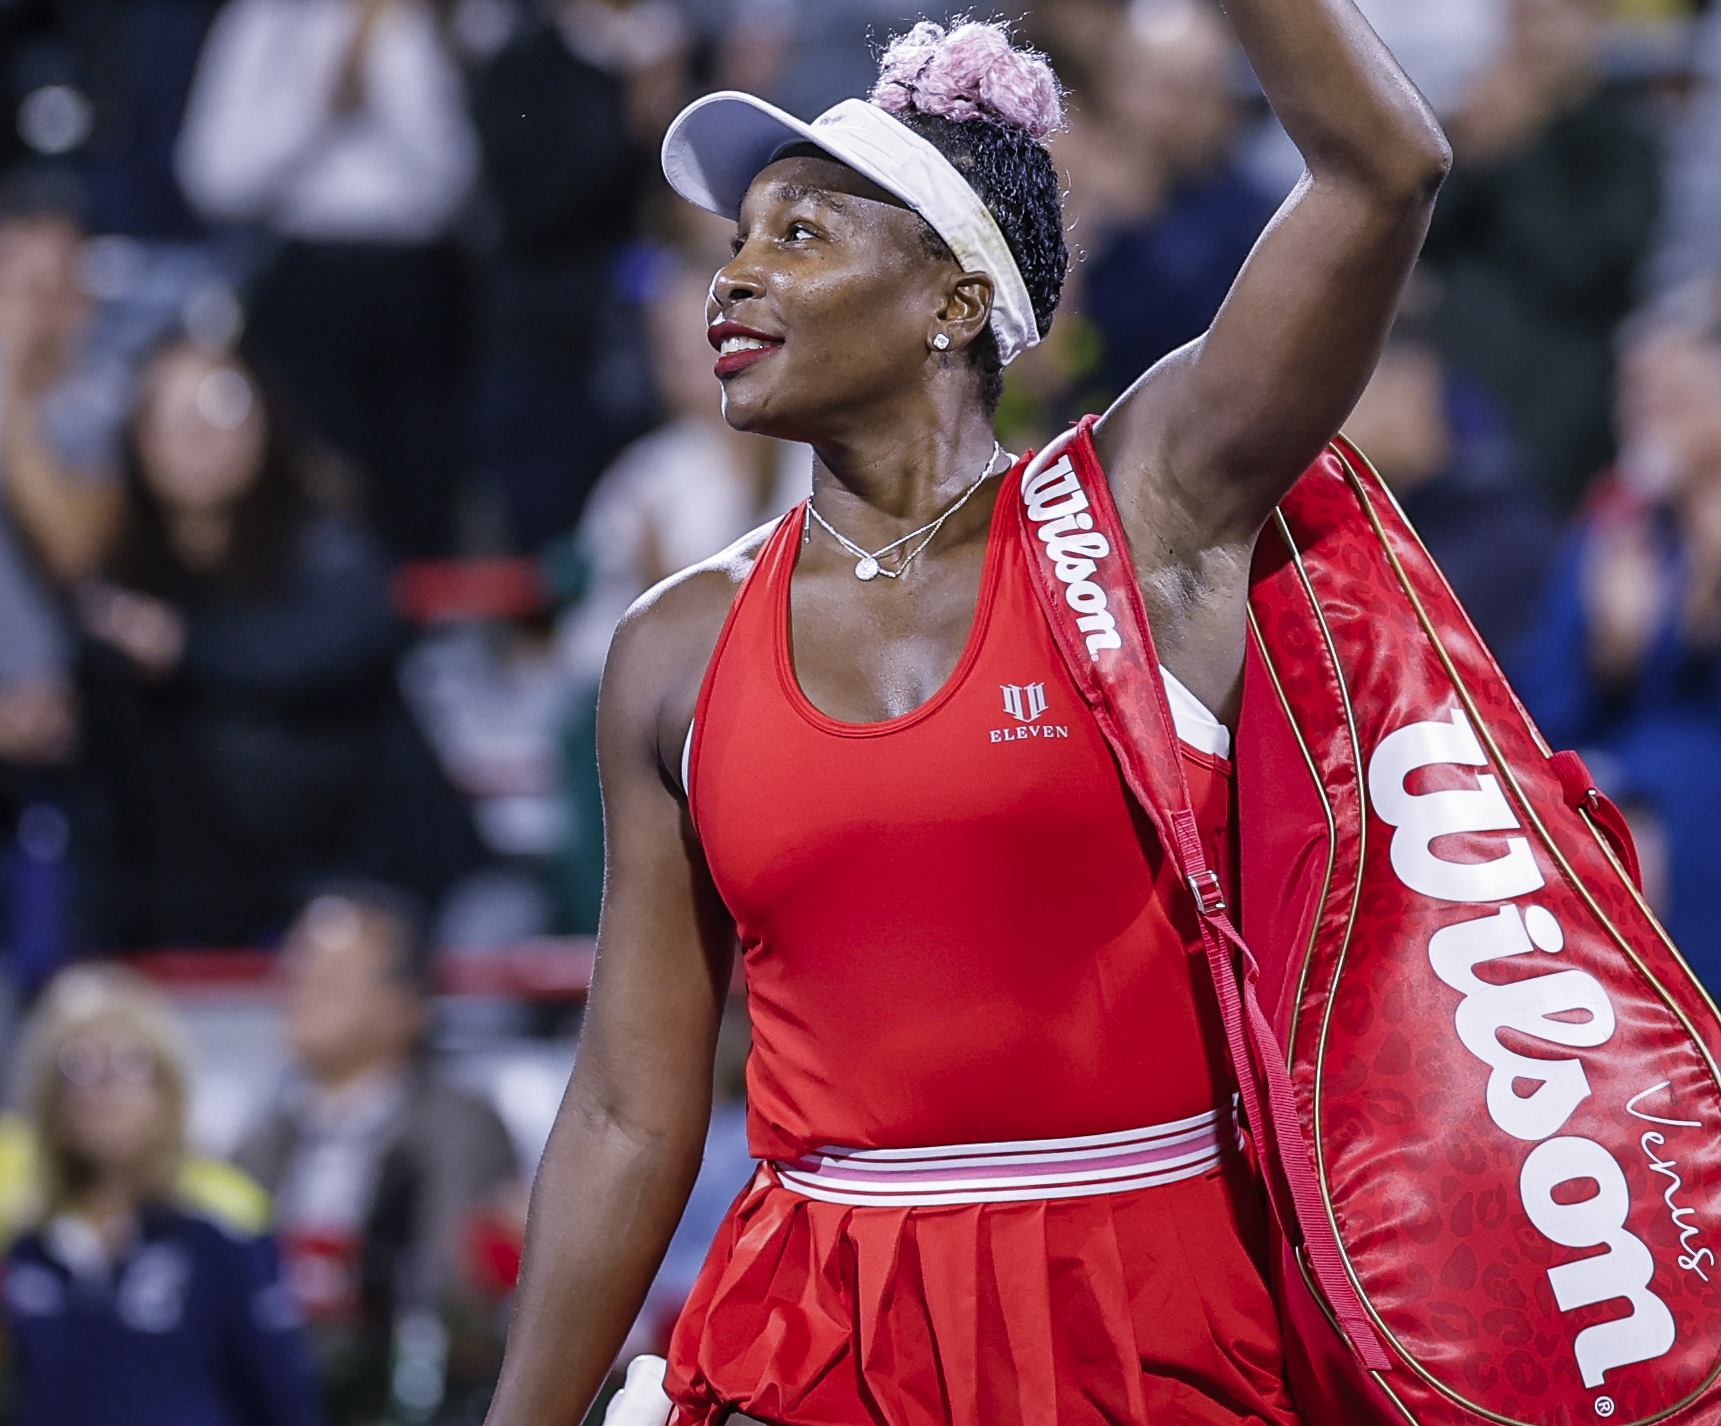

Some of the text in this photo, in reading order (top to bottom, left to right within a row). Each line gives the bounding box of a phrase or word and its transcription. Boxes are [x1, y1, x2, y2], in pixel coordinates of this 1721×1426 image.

[1023, 453, 1123, 657] Wilson
[989, 725, 1069, 743] ELEVEN
[1367, 706, 1677, 1390] Wilson
[1625, 1079, 1715, 1283] Venus
